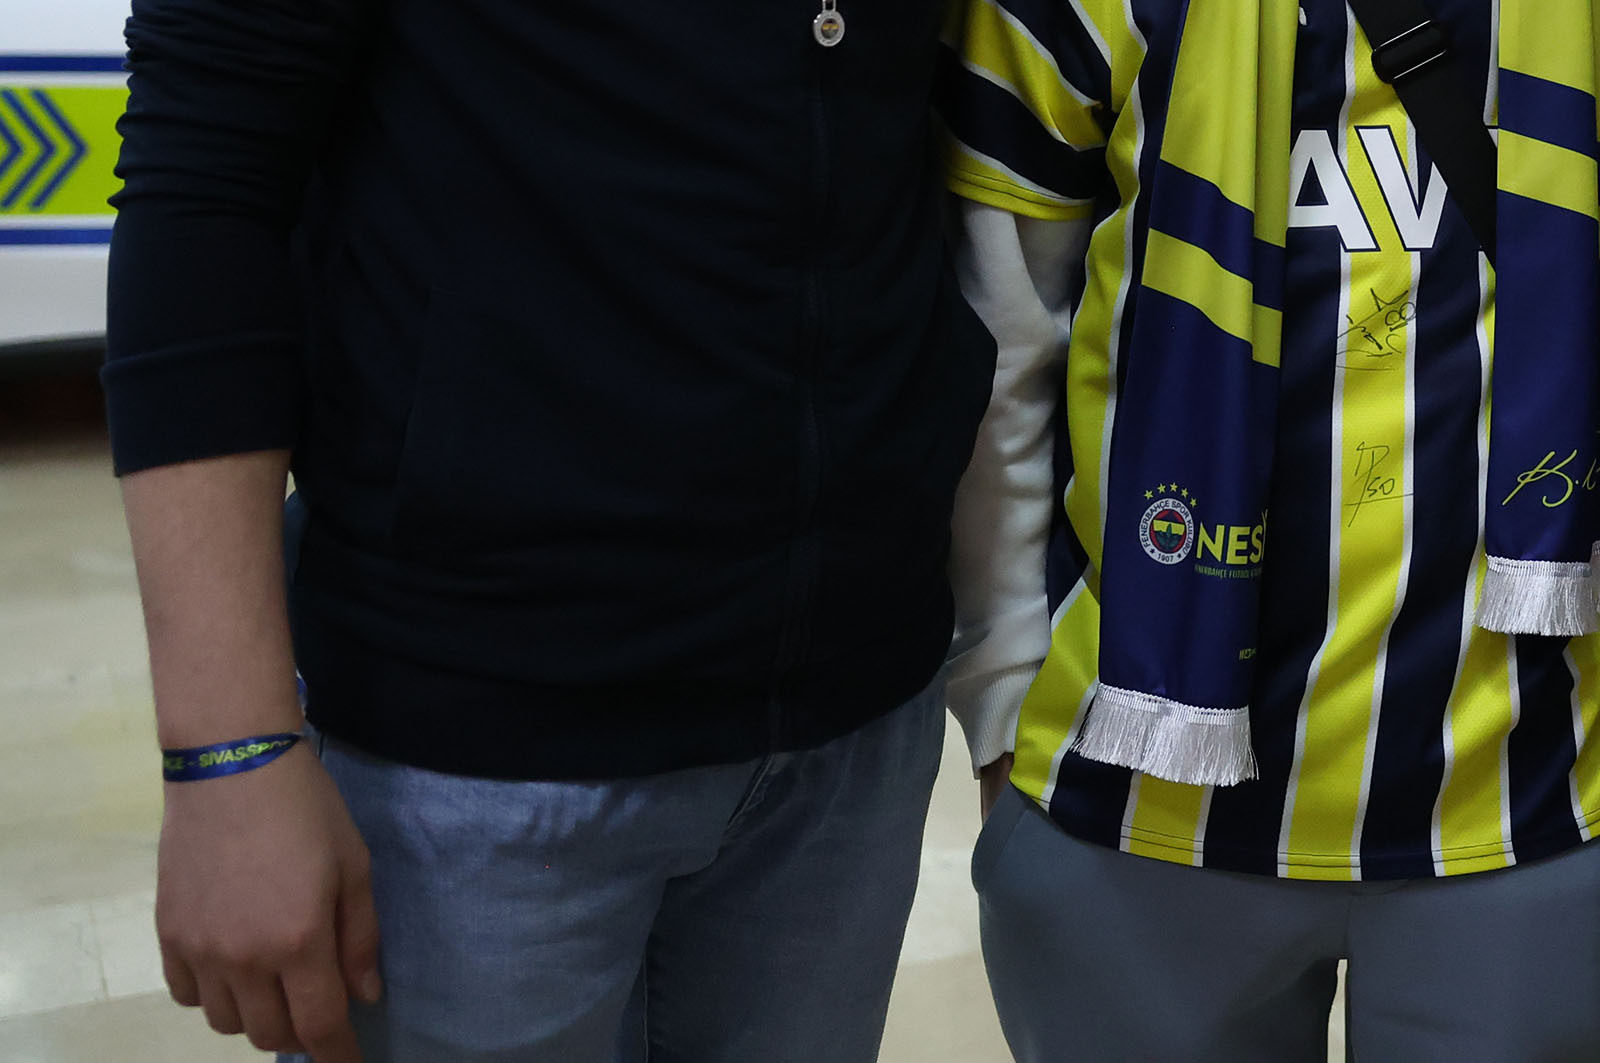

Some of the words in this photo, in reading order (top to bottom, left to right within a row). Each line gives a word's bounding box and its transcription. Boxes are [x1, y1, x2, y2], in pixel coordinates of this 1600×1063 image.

[1288, 126, 1449, 250] AV
[1141, 500, 1170, 549] FENERBAHÇE
[1171, 500, 1190, 519] SPOR
